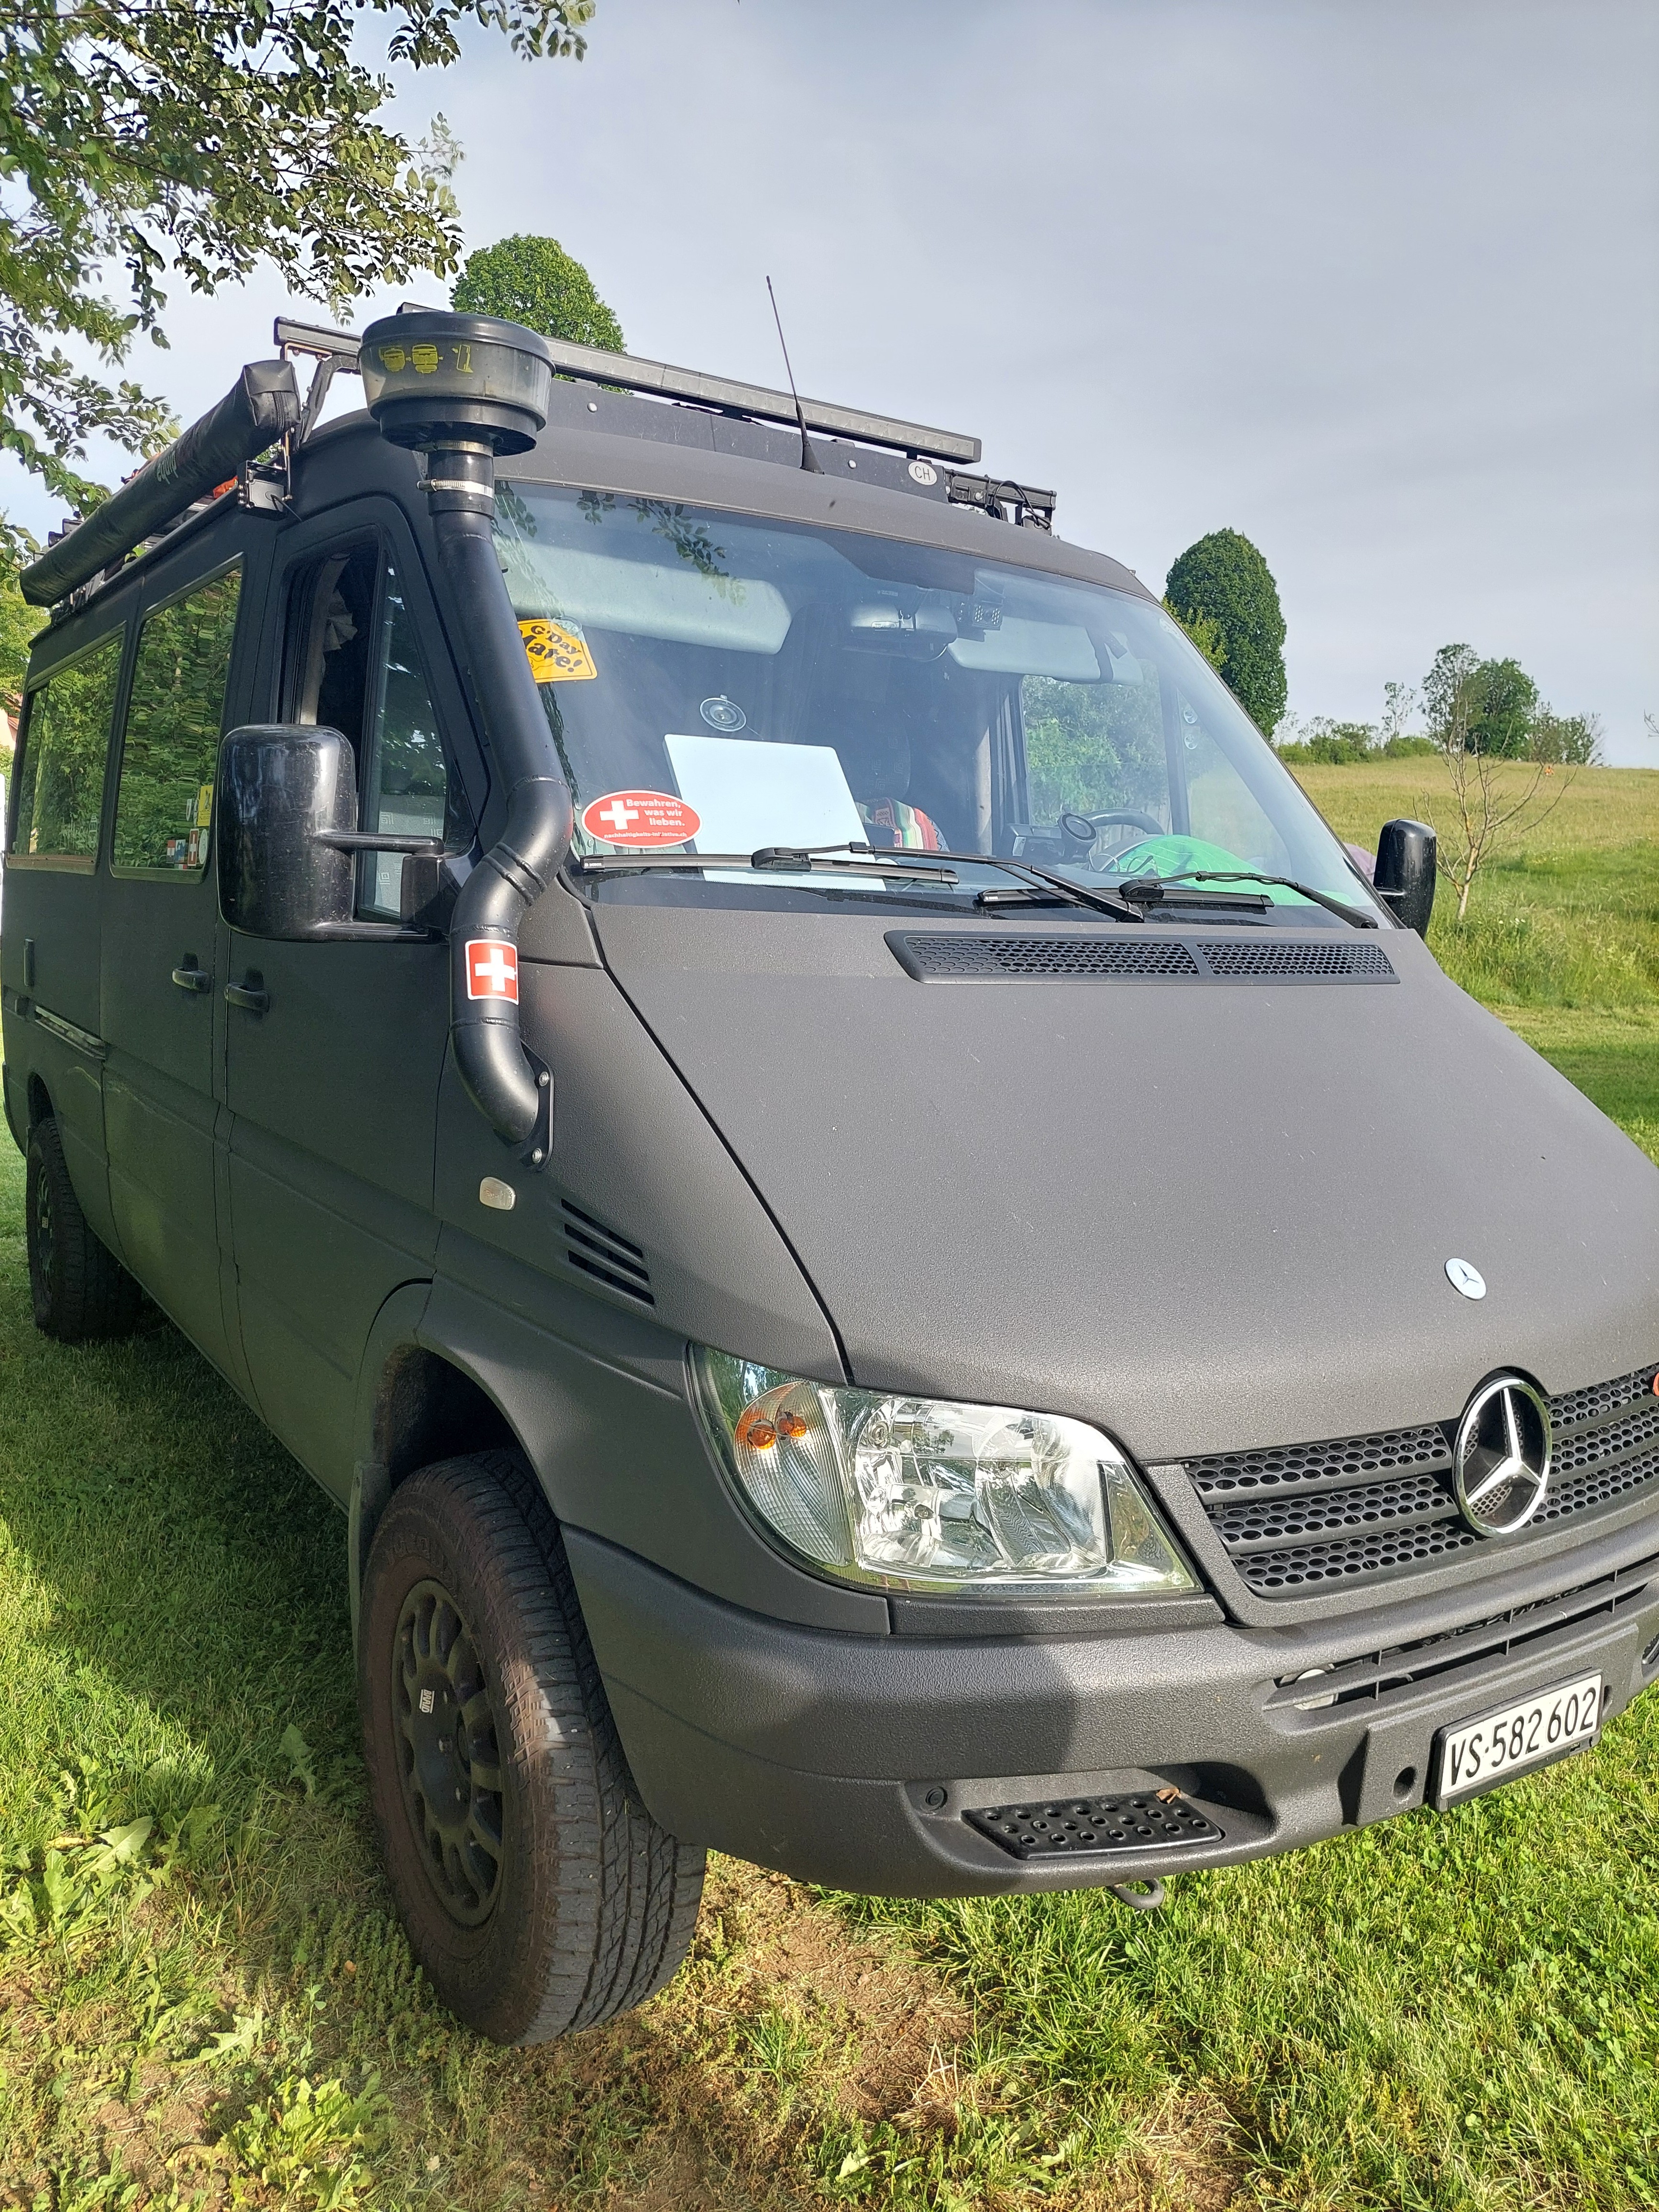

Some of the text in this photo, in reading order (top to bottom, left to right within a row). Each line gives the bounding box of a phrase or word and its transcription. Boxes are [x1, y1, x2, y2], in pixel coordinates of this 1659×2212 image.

[915, 465, 930, 481] CH
[531, 625, 582, 654] G'Day
[626, 798, 681, 808] Bewahren,
[666, 808, 683, 817] wir
[649, 817, 686, 826] lieben.
[421, 1689, 432, 1713] BRAID
